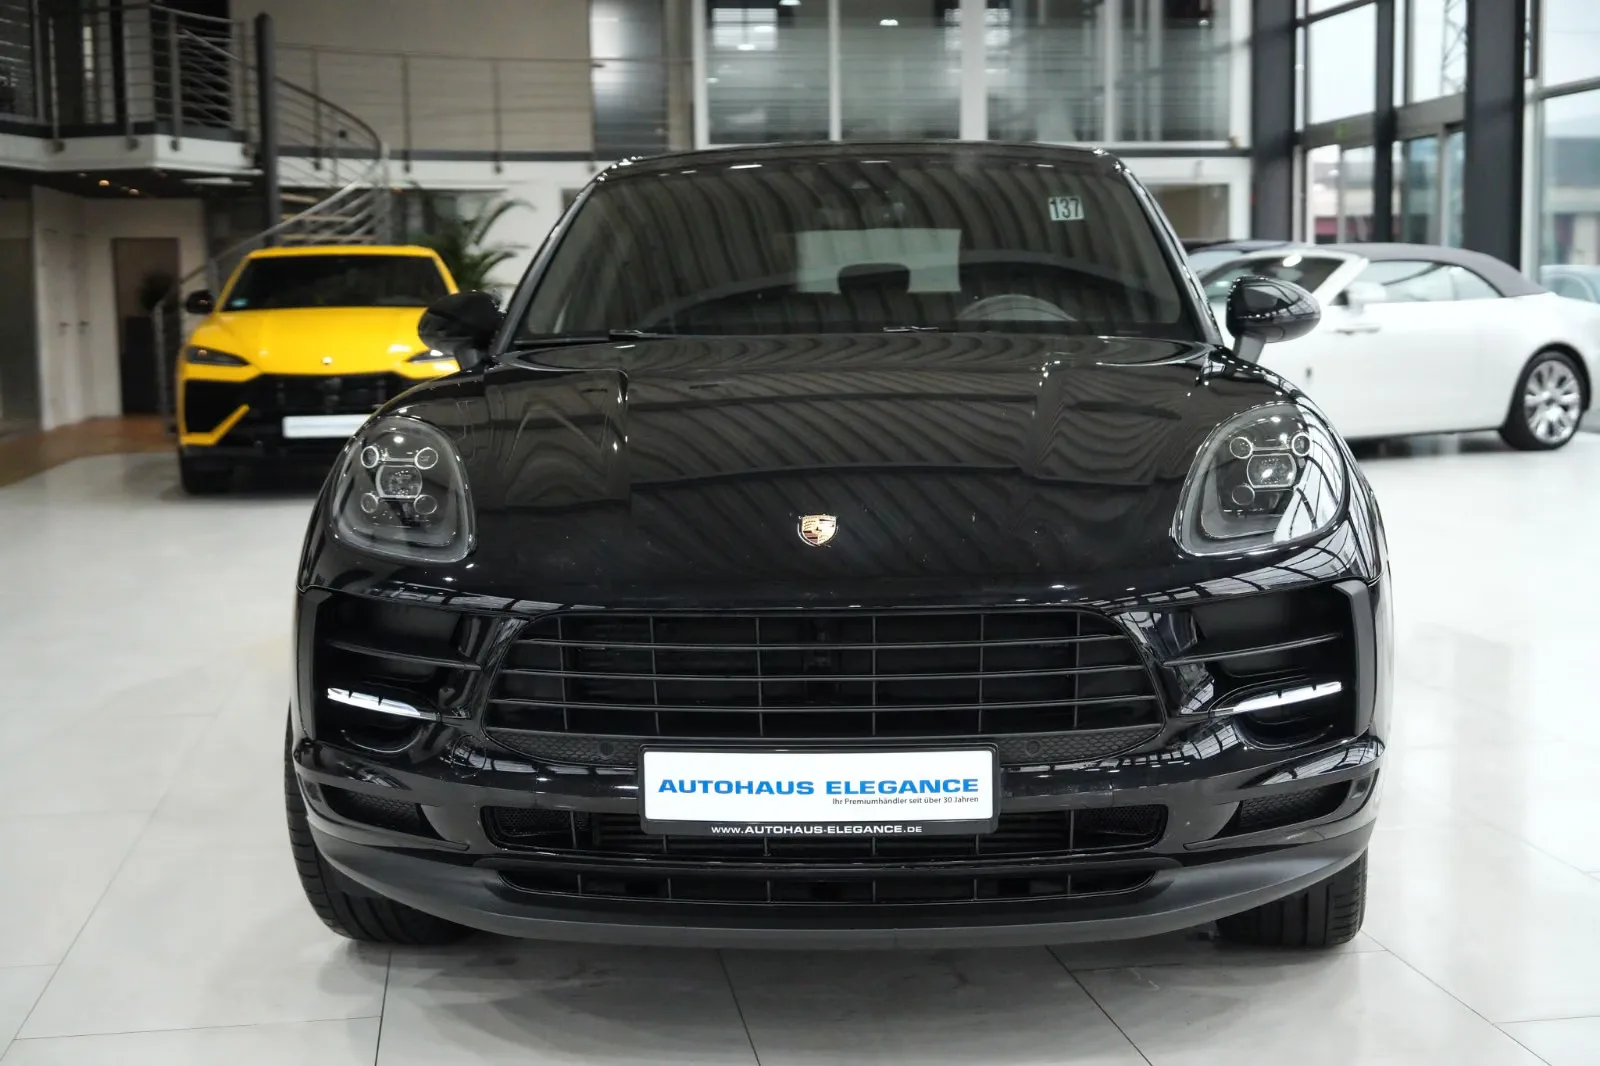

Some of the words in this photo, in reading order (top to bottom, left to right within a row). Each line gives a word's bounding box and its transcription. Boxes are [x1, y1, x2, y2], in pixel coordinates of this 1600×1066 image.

[1050, 197, 1079, 218] 137
[658, 779, 815, 795] AUTOHAUS
[826, 778, 979, 795] ELEGANCE
[832, 797, 843, 805] Ihr
[844, 796, 908, 805] Premiumhändler
[909, 796, 923, 804] seit
[924, 795, 942, 804] über
[943, 795, 953, 804] 30
[954, 795, 979, 804] Jahren
